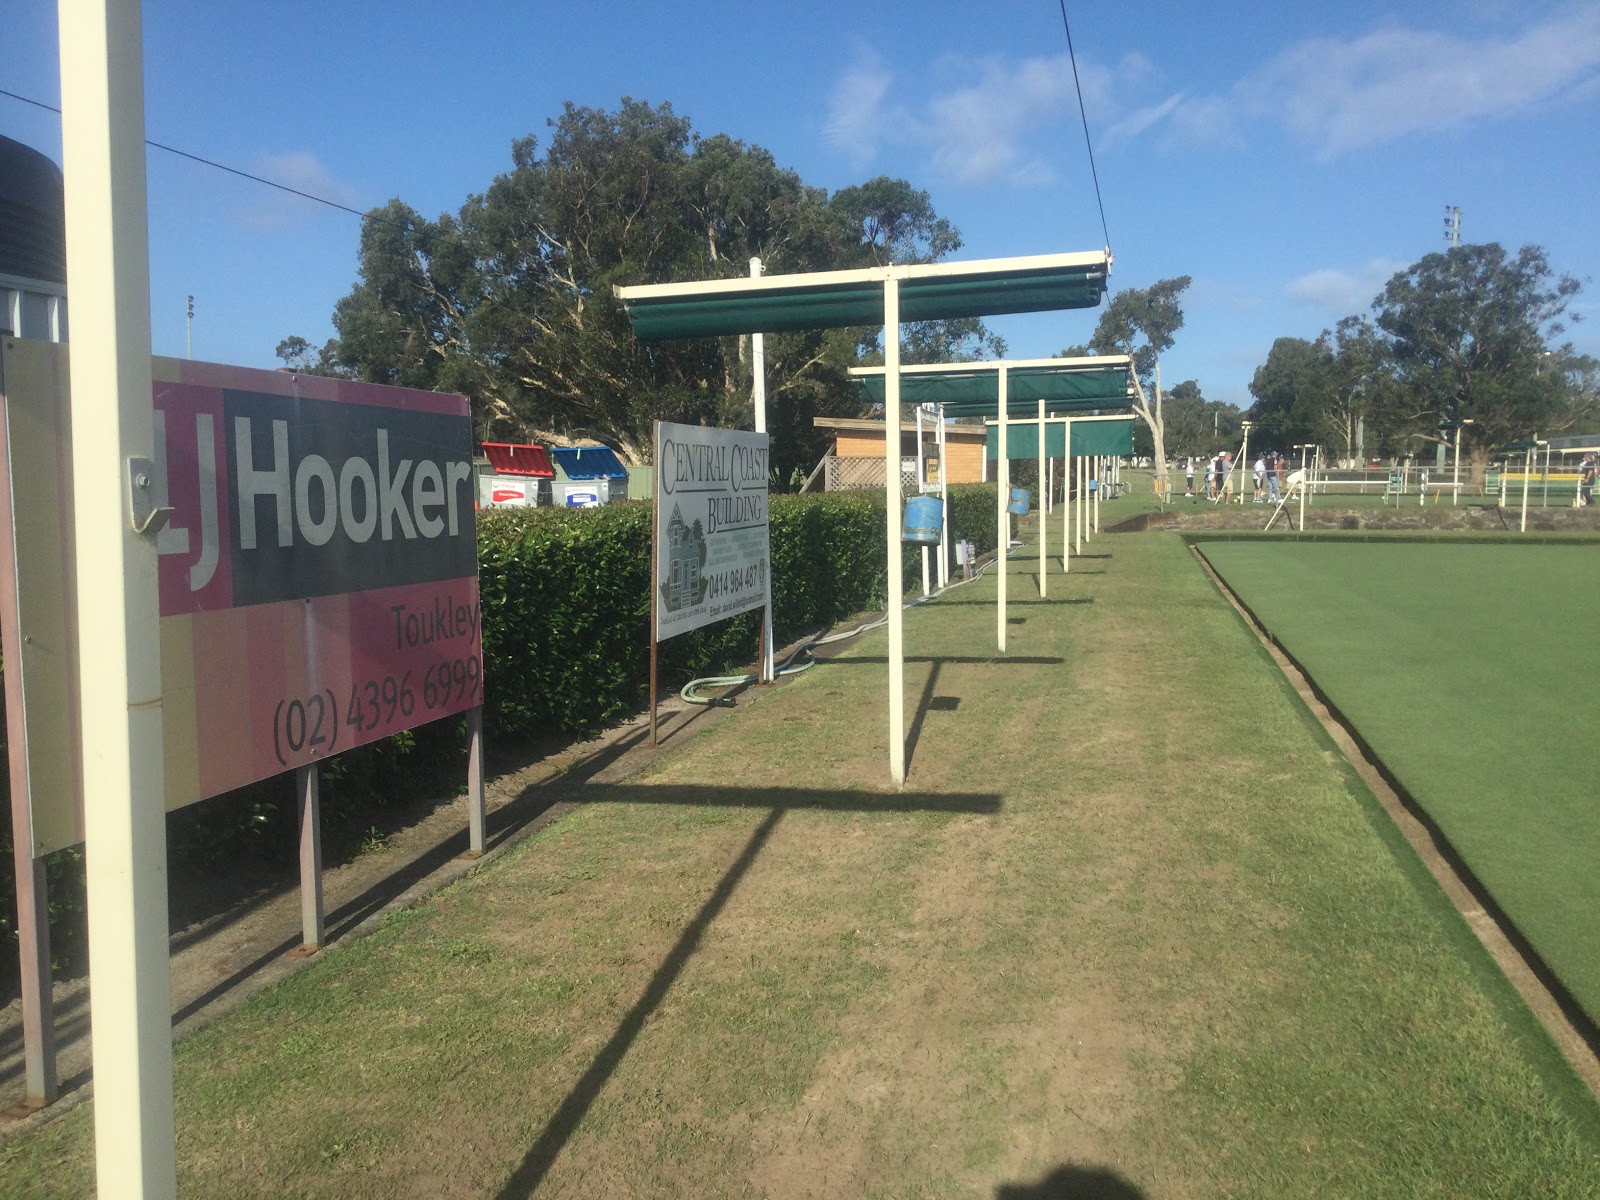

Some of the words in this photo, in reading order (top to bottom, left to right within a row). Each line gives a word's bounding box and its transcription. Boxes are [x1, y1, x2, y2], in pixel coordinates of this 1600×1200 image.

[234, 415, 471, 550] Hooker
[661, 438, 729, 496] CENTRAL
[731, 444, 768, 493] COAST
[707, 494, 762, 535] BUILDING
[709, 571, 729, 600] 0414
[731, 568, 744, 593] 964
[390, 595, 480, 650] Toukley
[273, 687, 339, 767] (02)
[346, 669, 415, 733] 4396
[423, 655, 480, 710] 6999
